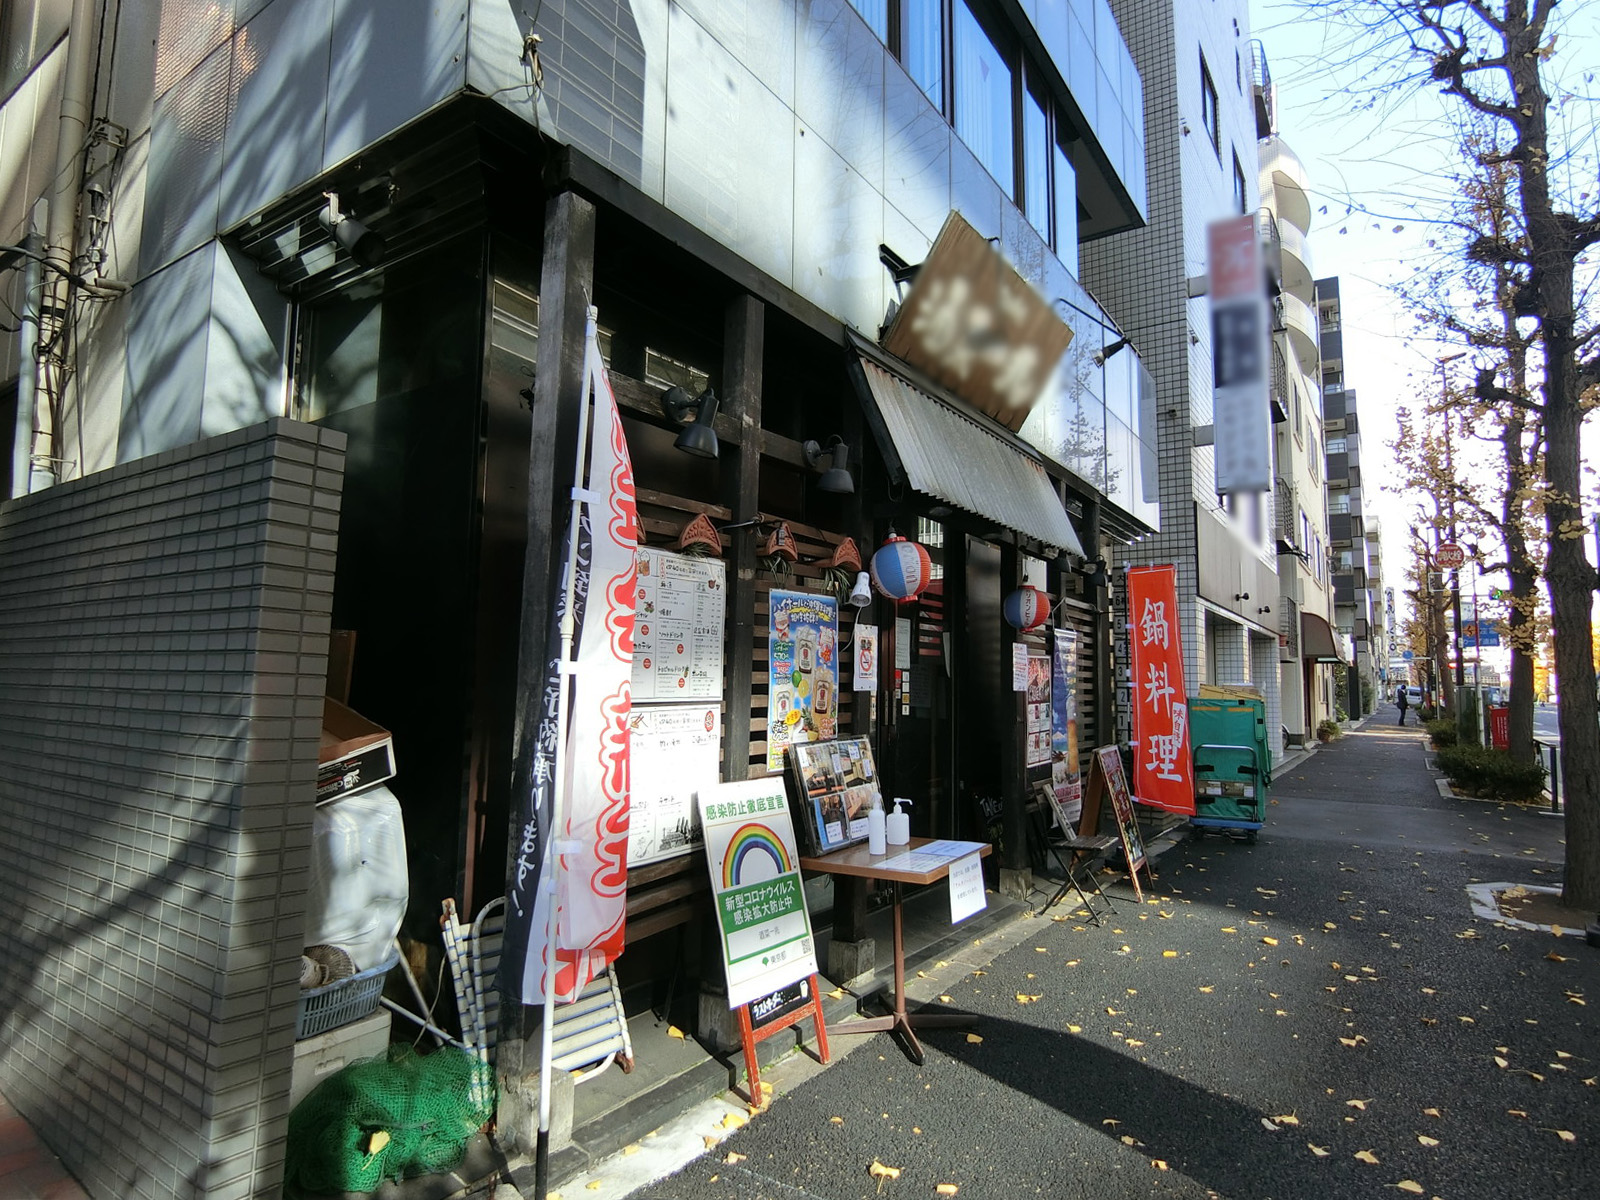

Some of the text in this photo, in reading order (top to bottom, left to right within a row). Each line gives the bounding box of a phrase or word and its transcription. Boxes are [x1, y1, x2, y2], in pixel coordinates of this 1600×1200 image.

[1120, 691, 1125, 702] 2
[1139, 597, 1182, 782] 鍋料理
[705, 795, 784, 821] 感染防止徹底宣言
[725, 881, 795, 911] 新型コロナウイルス
[733, 896, 793, 925] 感染拡大防止中
